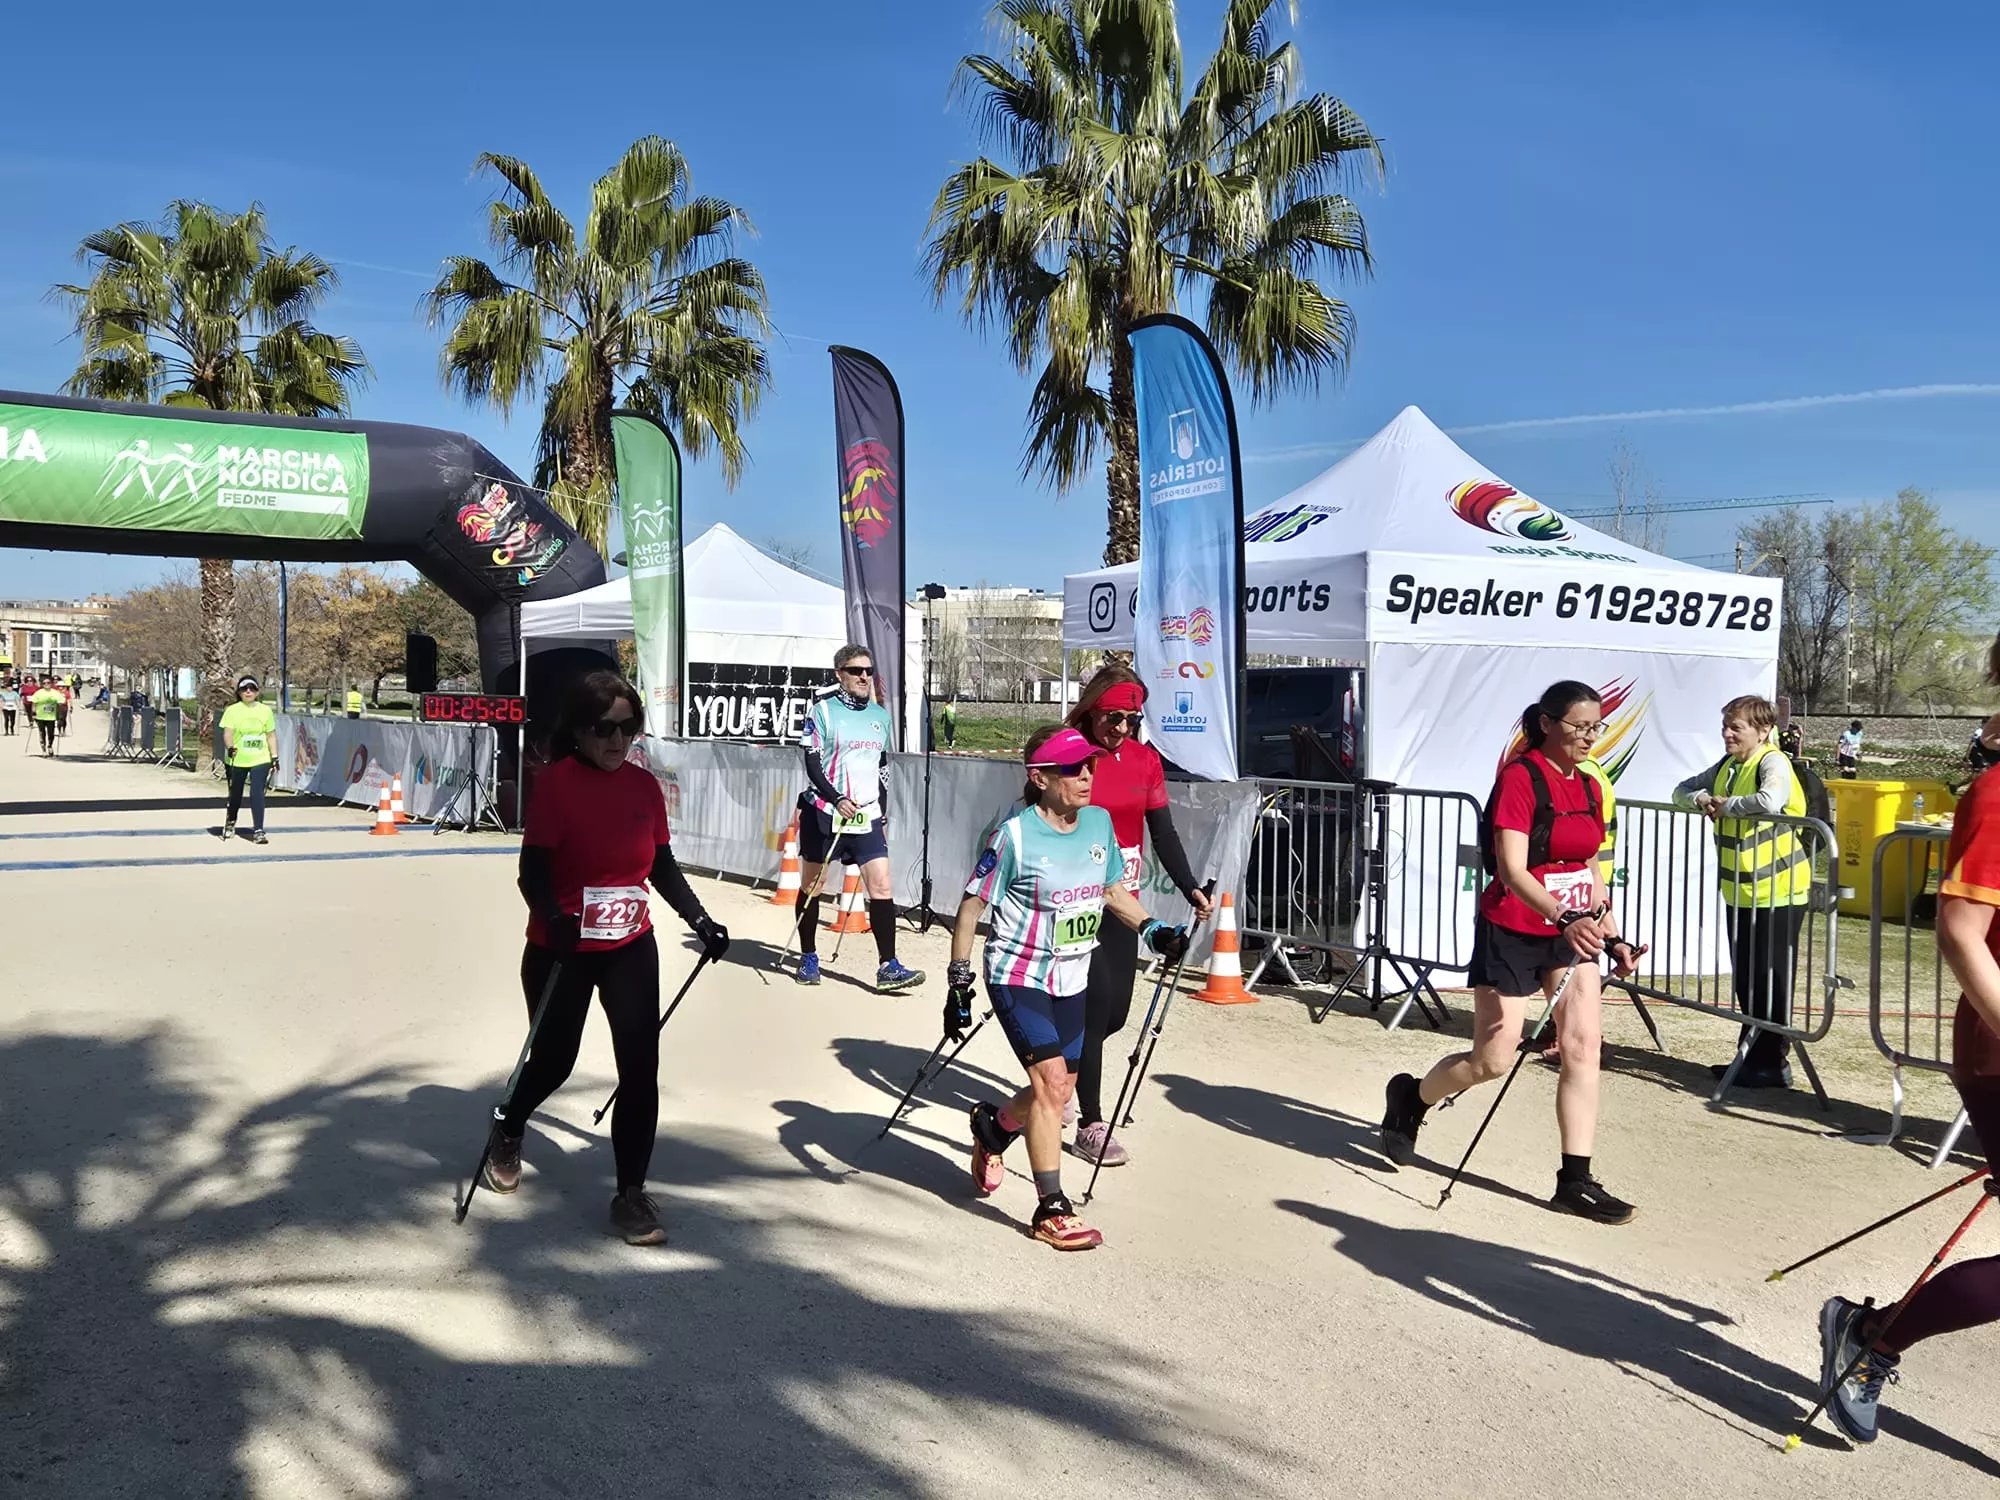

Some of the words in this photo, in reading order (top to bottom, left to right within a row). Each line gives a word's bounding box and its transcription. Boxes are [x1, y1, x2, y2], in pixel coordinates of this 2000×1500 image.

[0, 426, 48, 463] A
[217, 445, 345, 473] MARCHA
[222, 492, 277, 507] FEDME
[1486, 545, 1559, 558] Rioja
[1556, 546, 1638, 564] Sports
[1385, 573, 1544, 625] Speaker
[1555, 581, 1774, 632] 619238728
[425, 695, 523, 721] 00:25:26
[693, 695, 746, 736] YOU
[847, 739, 883, 751] carena
[1558, 886, 1589, 909] 214
[595, 901, 639, 924] 229
[1065, 913, 1098, 939] 102
